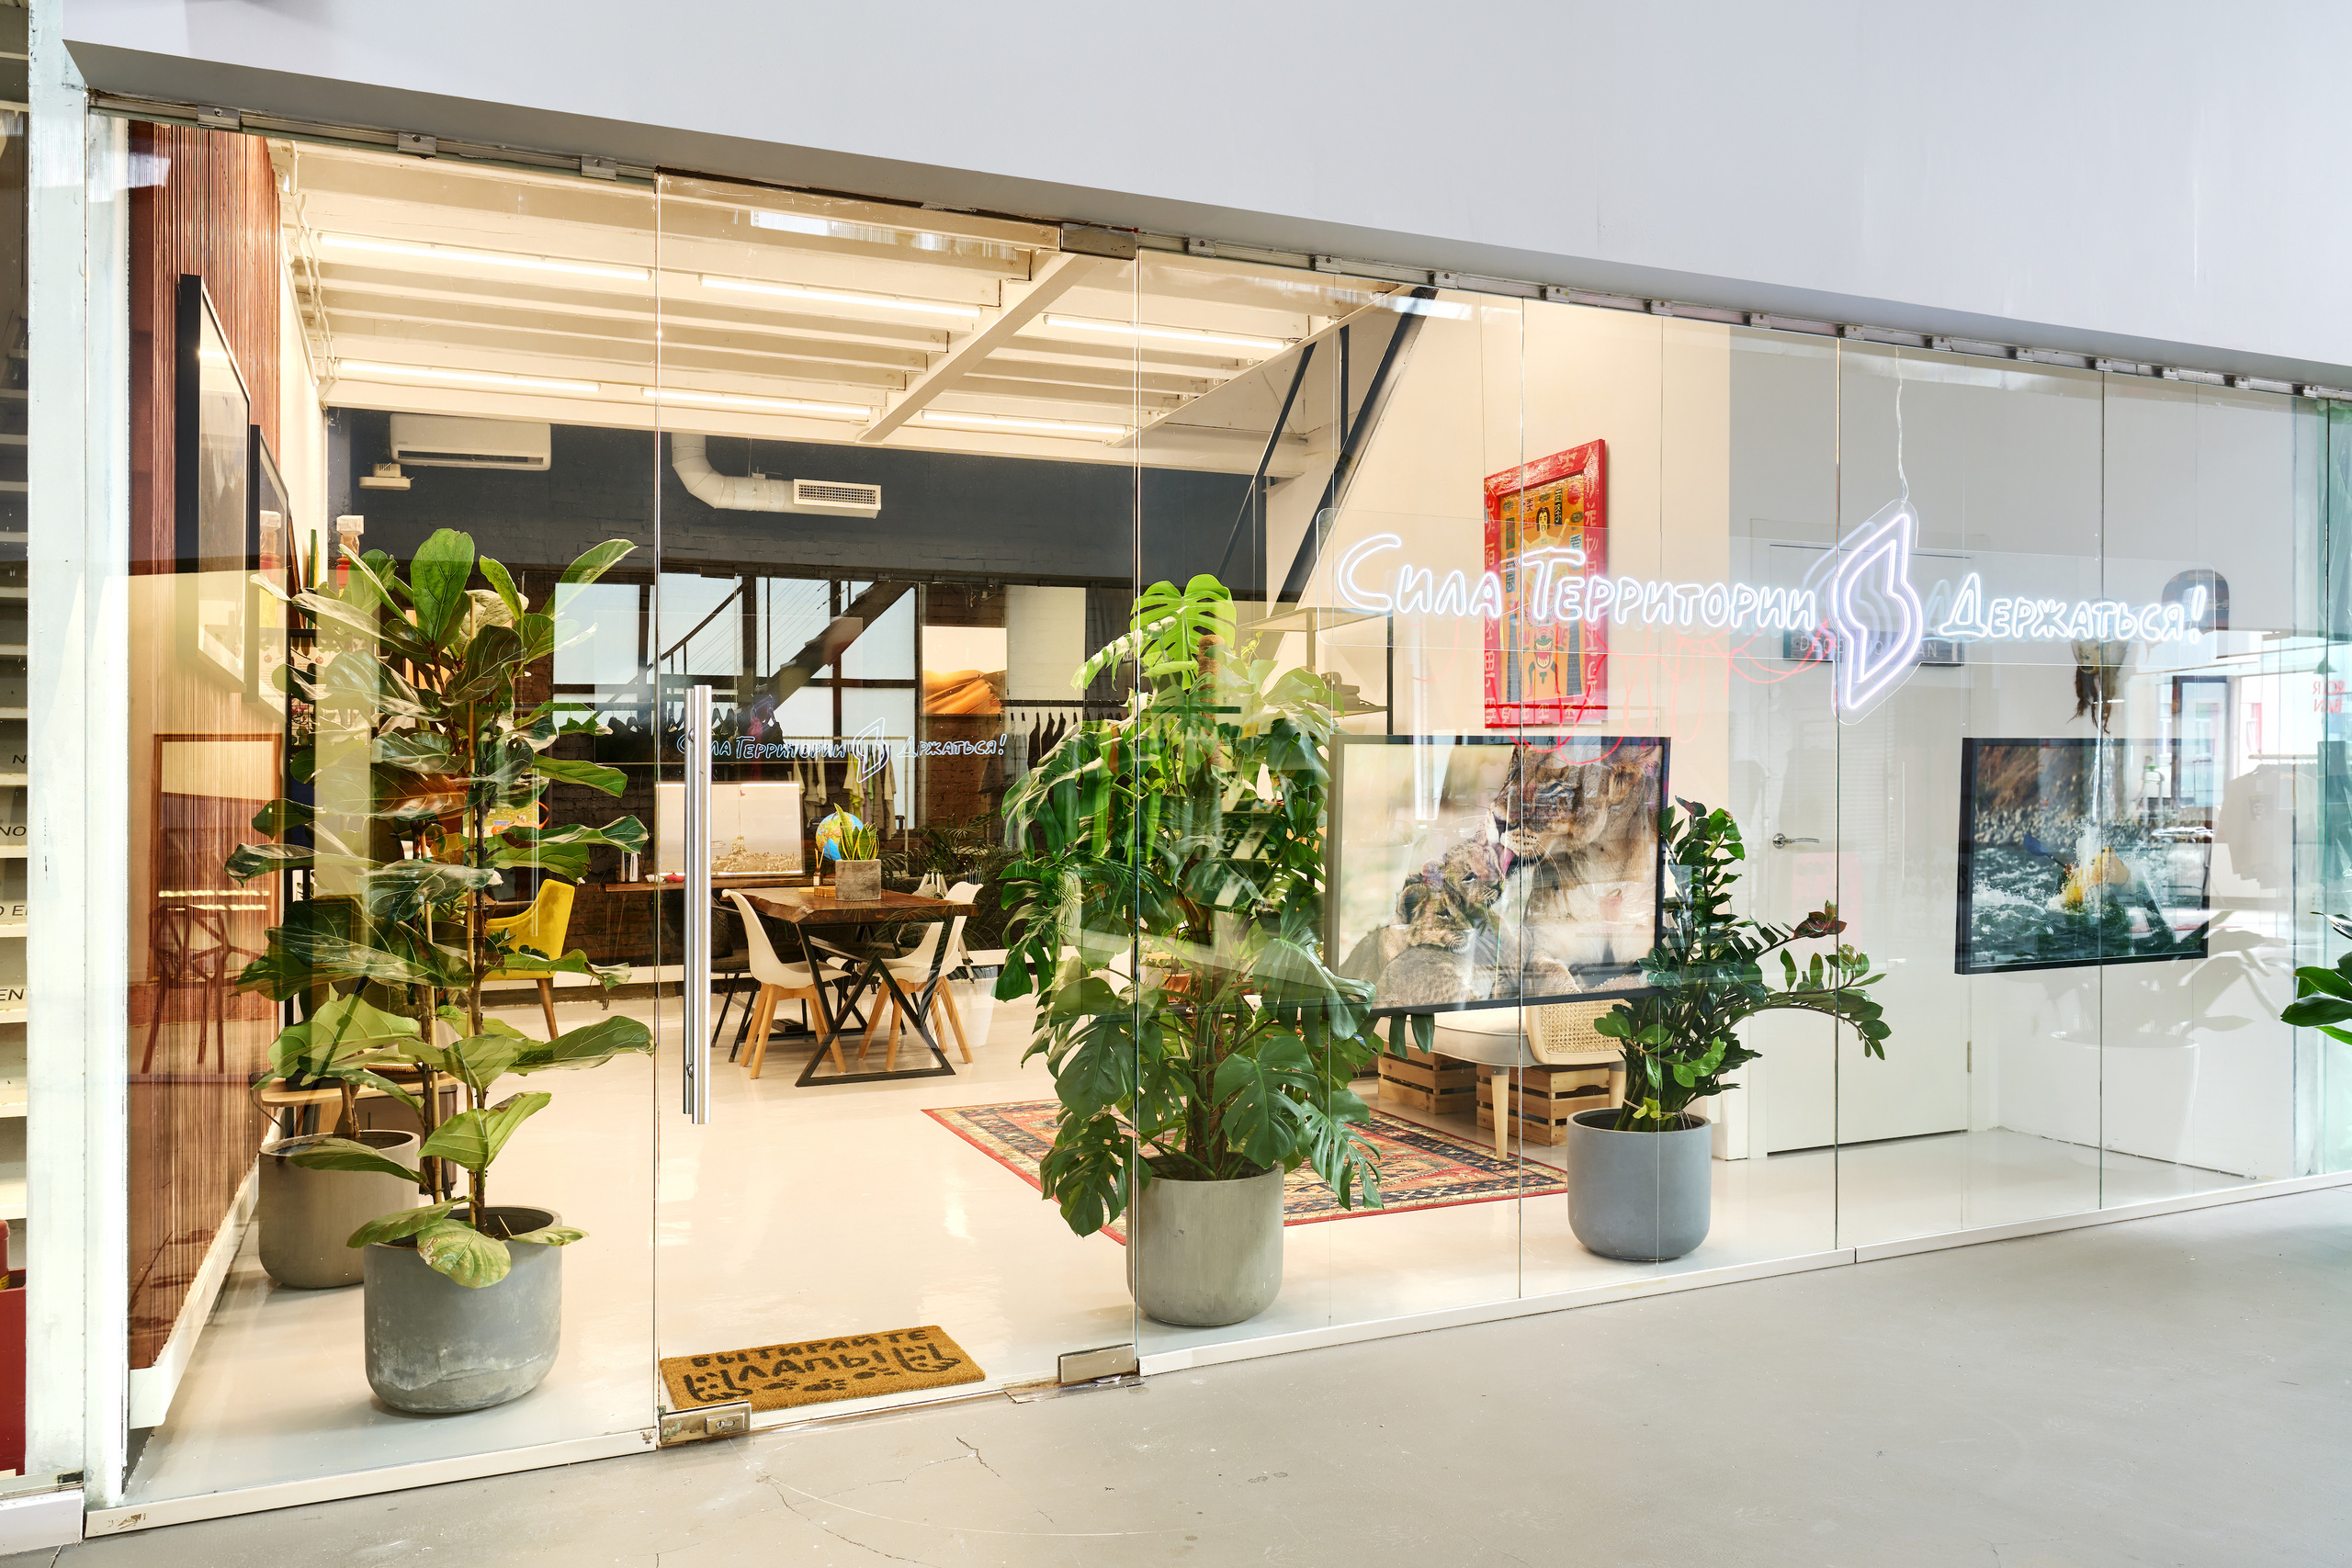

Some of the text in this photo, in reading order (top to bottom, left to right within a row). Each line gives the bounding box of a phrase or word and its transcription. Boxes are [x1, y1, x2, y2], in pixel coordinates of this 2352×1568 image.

[1338, 534, 1501, 619] СИЛА
[1521, 546, 1817, 631] ТЕРРИТОРИИ
[1939, 572, 2207, 645] ДЕРЖАТЬСЯ!
[690, 1329, 929, 1368] ВЫТИРАЙТЕ
[739, 1350, 888, 1382] ЛАПЫ
